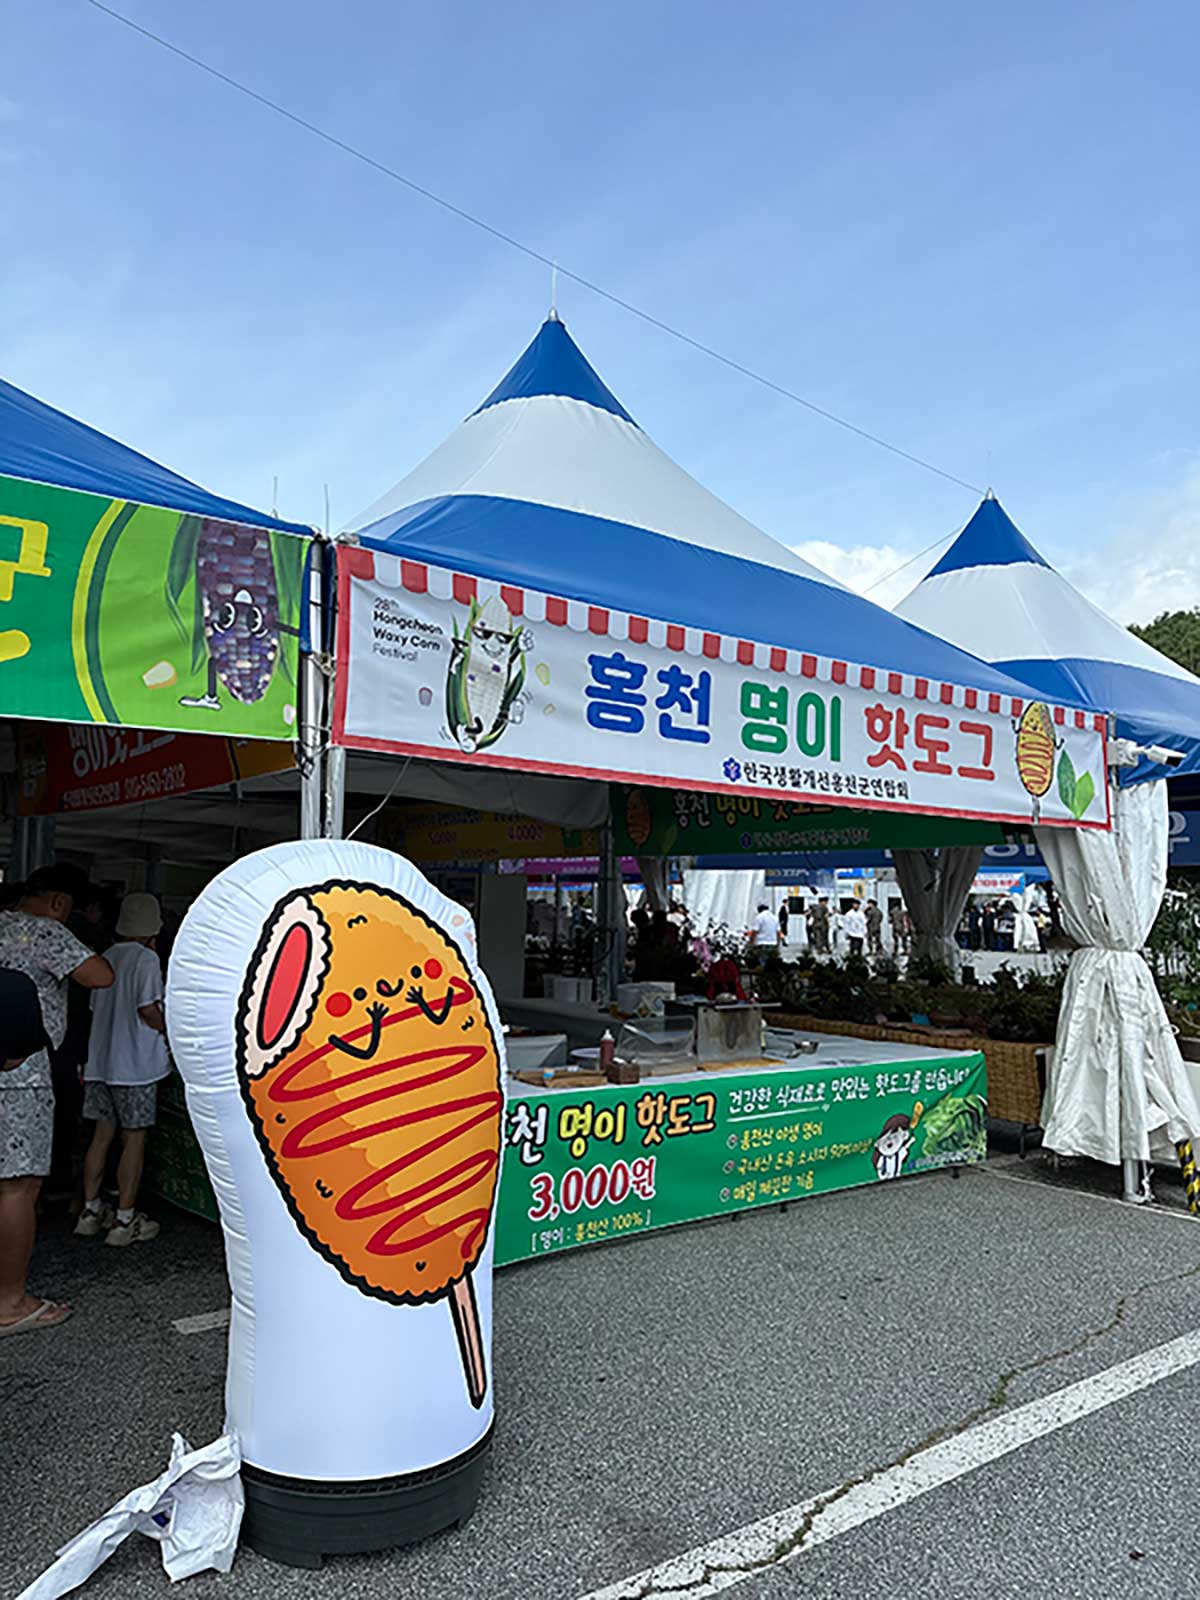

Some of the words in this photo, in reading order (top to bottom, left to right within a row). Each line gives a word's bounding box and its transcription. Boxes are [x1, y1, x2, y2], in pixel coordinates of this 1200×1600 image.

[373, 610, 443, 635] Hongcheon
[373, 627, 408, 647] Waxy
[410, 635, 441, 651] Corn
[373, 642, 418, 661] Festival
[584, 652, 712, 744] 홍천
[740, 681, 841, 762] 명이
[864, 703, 995, 781] 핫도그
[672, 792, 711, 828] 홍천
[729, 1087, 772, 1114] 건강한
[776, 1083, 826, 1108] 식재료로
[831, 1076, 870, 1101] 맛있는
[875, 1070, 922, 1097] 핫도그를
[503, 1104, 546, 1163] 천
[560, 1102, 625, 1158] 명이
[637, 1093, 715, 1145] 핫도그
[802, 1121, 823, 1140] 명이
[527, 1156, 657, 1221] 3,000원
[540, 1227, 563, 1250] 명이
[612, 1212, 643, 1230] 100%
